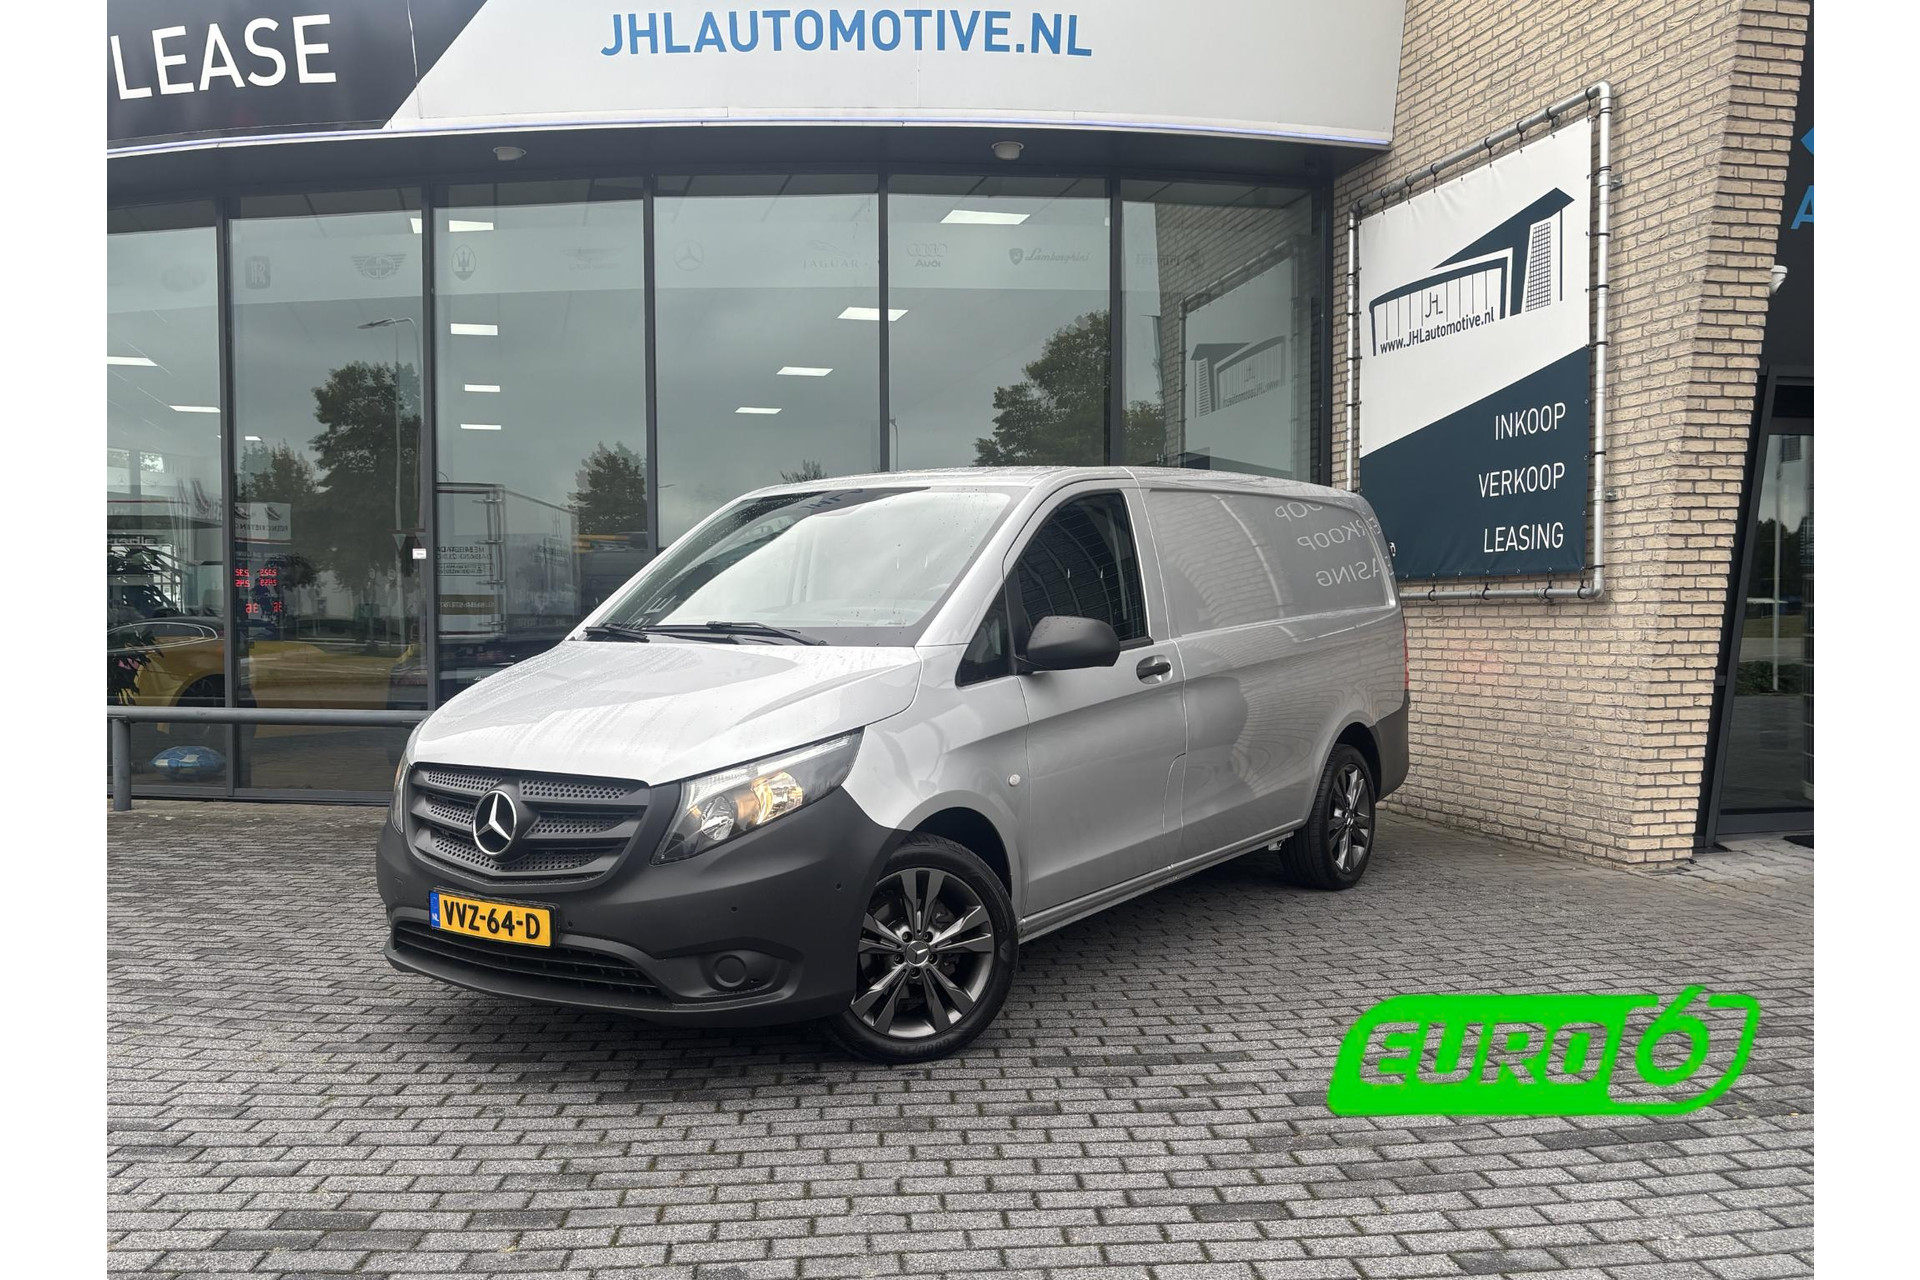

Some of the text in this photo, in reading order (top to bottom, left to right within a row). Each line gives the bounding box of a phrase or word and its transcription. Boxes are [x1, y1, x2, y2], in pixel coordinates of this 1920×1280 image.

[601, 9, 1093, 57] JHLAUTOMOTIVE.NL
[110, 14, 337, 100] LEASE
[1025, 247, 1090, 264] Lamborghini
[1380, 306, 1495, 354] www.JHLautomotive.nl
[1495, 402, 1566, 441] INKOOP
[1478, 462, 1566, 498] VERKOOP
[1483, 522, 1564, 553] LEASING
[443, 900, 541, 939] VVZ-64-D
